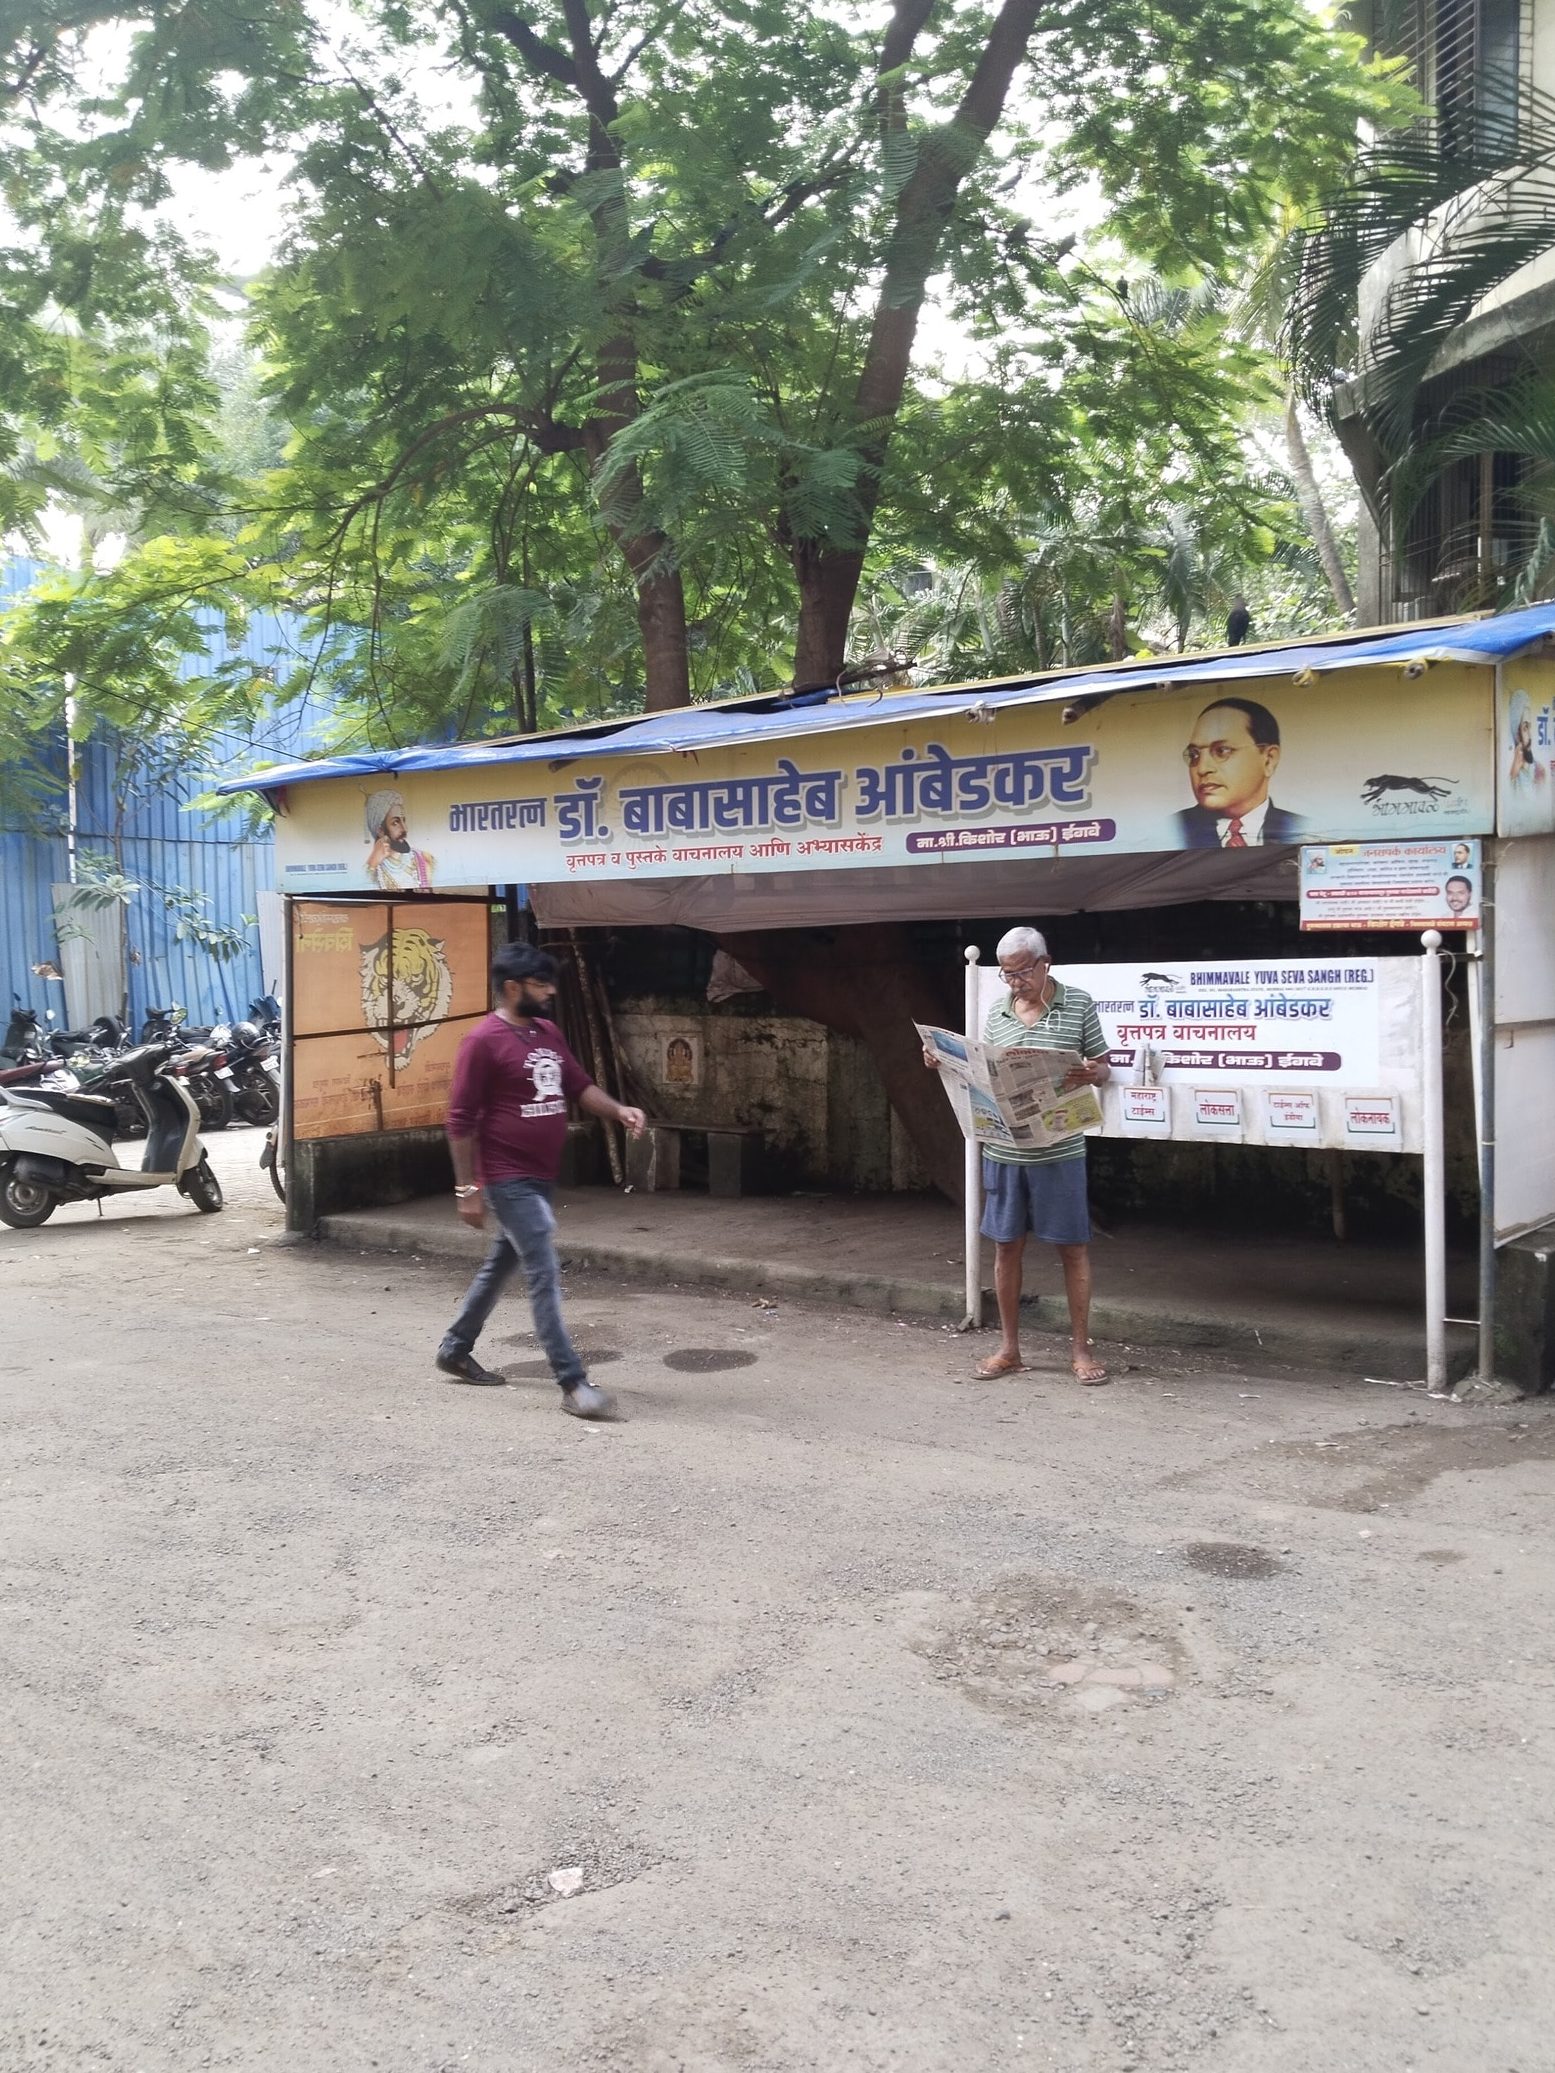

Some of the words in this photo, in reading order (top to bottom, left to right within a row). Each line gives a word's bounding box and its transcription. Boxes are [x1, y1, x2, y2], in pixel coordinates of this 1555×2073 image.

[450, 797, 547, 832] भारतरत्न
[554, 777, 609, 838] डॉ.
[619, 759, 842, 834] बाबासाहेब
[855, 744, 1091, 816] आंबेडकर
[566, 853, 606, 873] वृत्तपत्र
[611, 852, 621, 864] व
[626, 845, 667, 869] पुस्तके
[672, 845, 744, 861] वाचनालय
[750, 837, 790, 857] आणि
[1190, 971, 1250, 985] BHIMMAVALE
[1254, 970, 1278, 985] YUVA
[1281, 970, 1305, 984] SEVA
[1308, 969, 1341, 983] SANGH
[1138, 994, 1160, 1018] डॉ.
[1166, 994, 1249, 1018] बाबासाहेब
[1254, 993, 1332, 1018] आंबेडकर
[1117, 1025, 1167, 1046] वृत्तपत्र
[1173, 1025, 1257, 1041] वाचनालय
